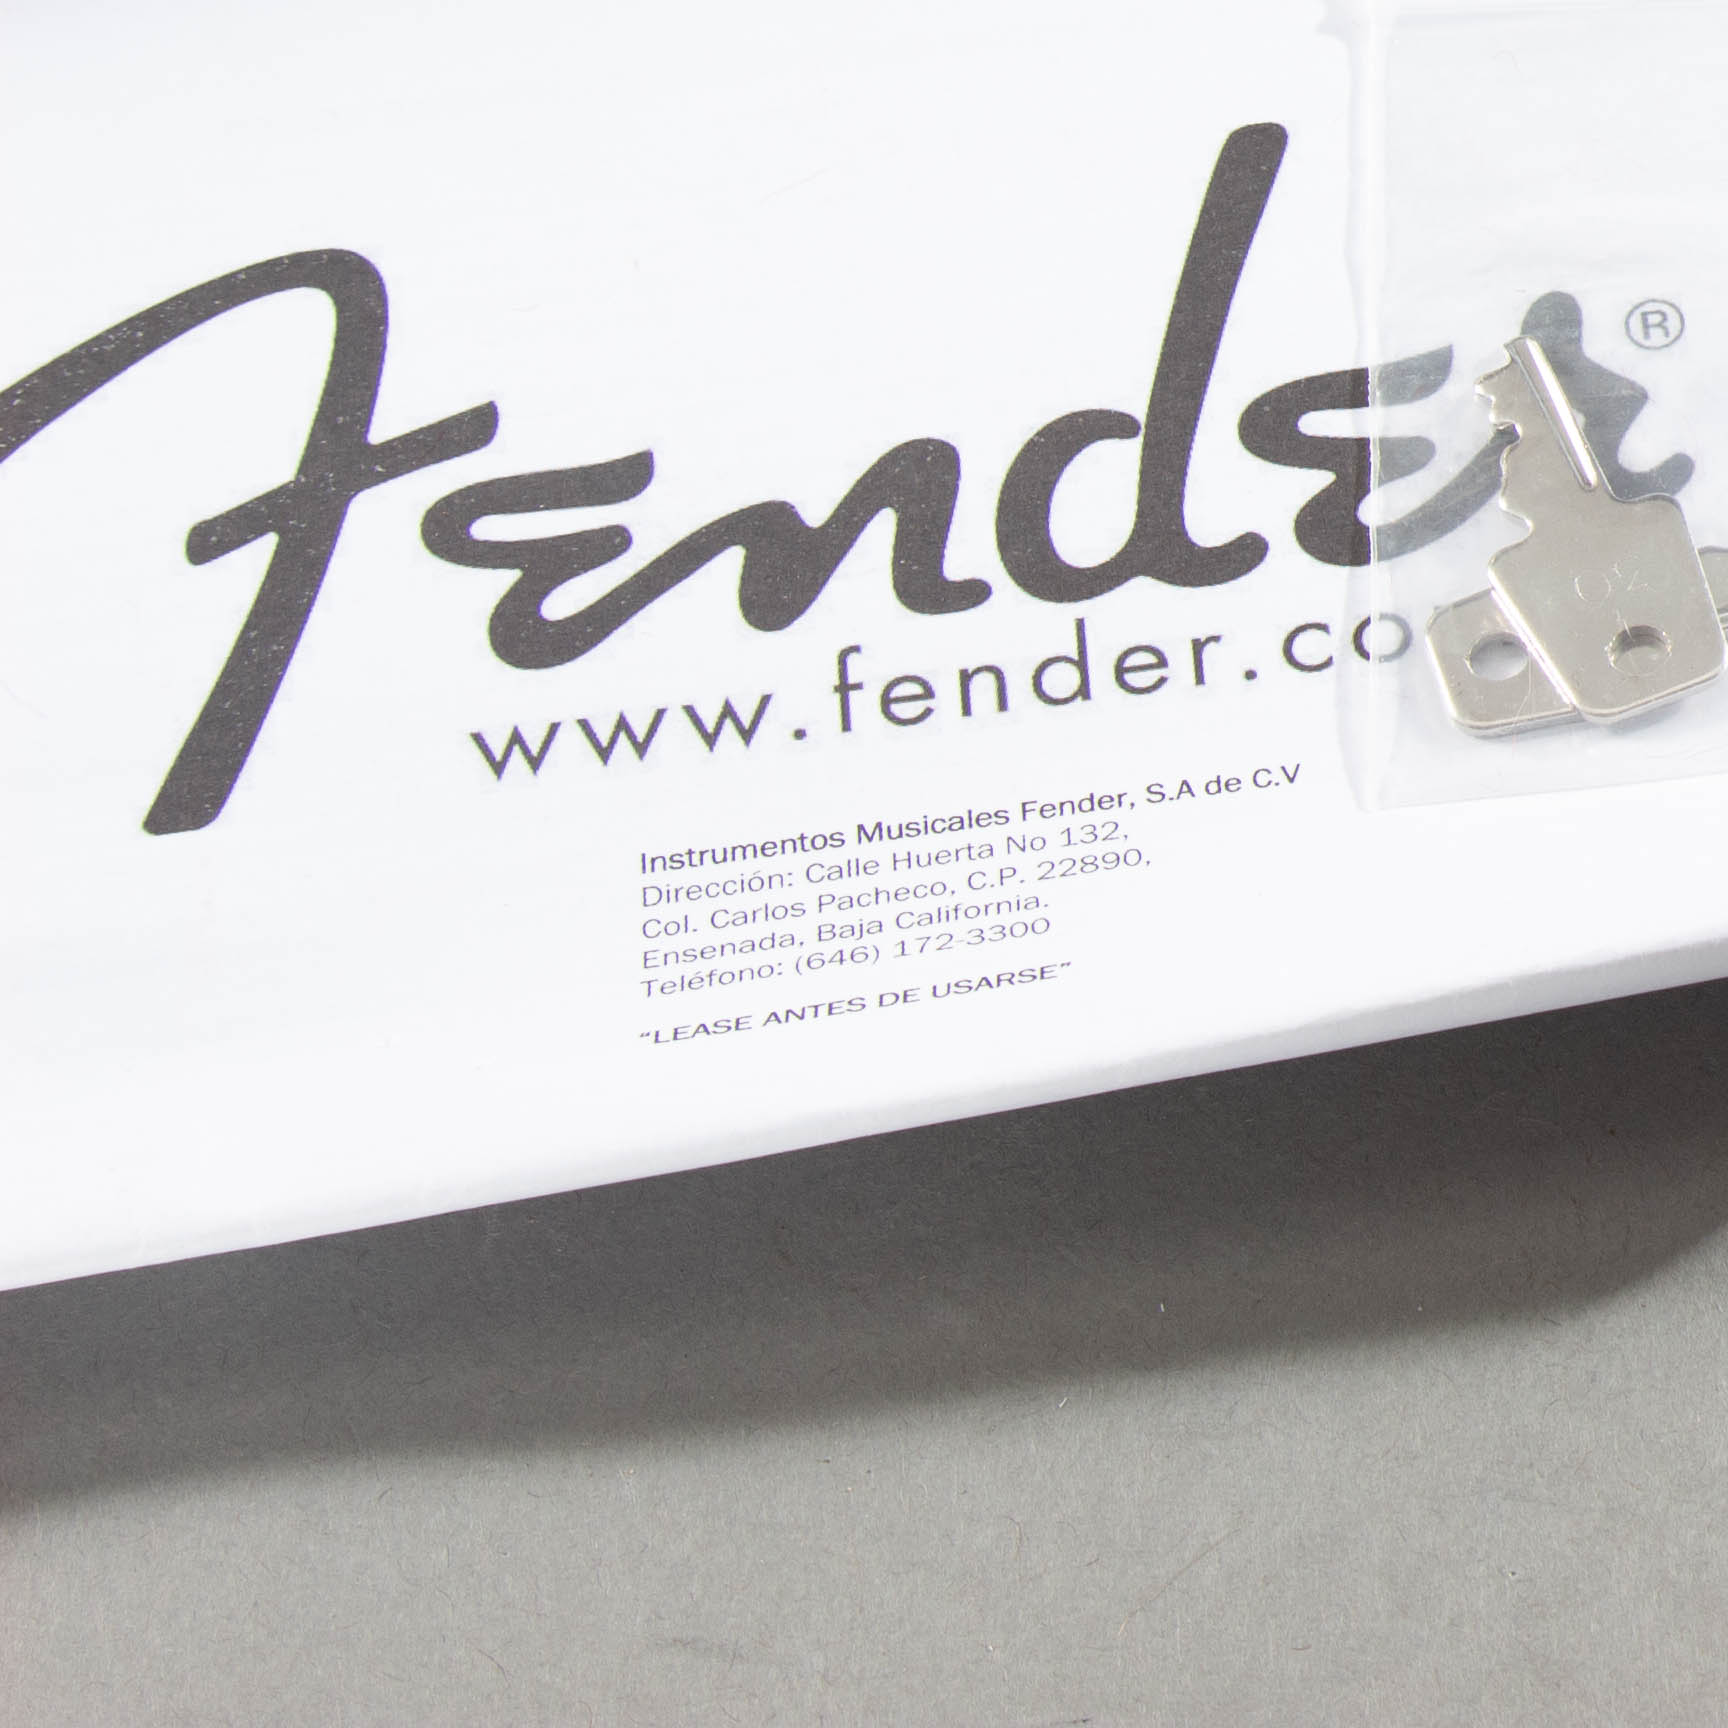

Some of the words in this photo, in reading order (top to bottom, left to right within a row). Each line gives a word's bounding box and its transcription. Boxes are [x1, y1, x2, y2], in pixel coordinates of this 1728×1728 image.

[470, 611, 1413, 780] www.fender.co
[641, 832, 845, 873] Instrumentos
[857, 809, 1010, 845] Musicales
[1021, 791, 1135, 822] Fender,
[1146, 780, 1195, 804] S.A
[1205, 775, 1242, 796] de
[1252, 763, 1300, 789] C.V
[642, 871, 793, 907] Dirección:
[805, 858, 880, 884] Calle
[892, 843, 994, 871] Huerta
[1006, 835, 1046, 855] No
[1060, 821, 1128, 848] 132,
[642, 915, 698, 939] Col.
[711, 902, 806, 930] Carlos
[818, 881, 956, 913] Pacheco,
[967, 867, 1025, 891] C.P.
[1037, 848, 1151, 882] 22890,
[640, 962, 783, 998] Teléfono:
[795, 945, 880, 976] (646)
[893, 918, 1051, 958] 172-3300
[643, 932, 803, 969] Ensenada,
[817, 919, 883, 943] Baja
[896, 894, 1048, 930] California.
[762, 997, 866, 1026] ANTES
[878, 988, 921, 1007] DE
